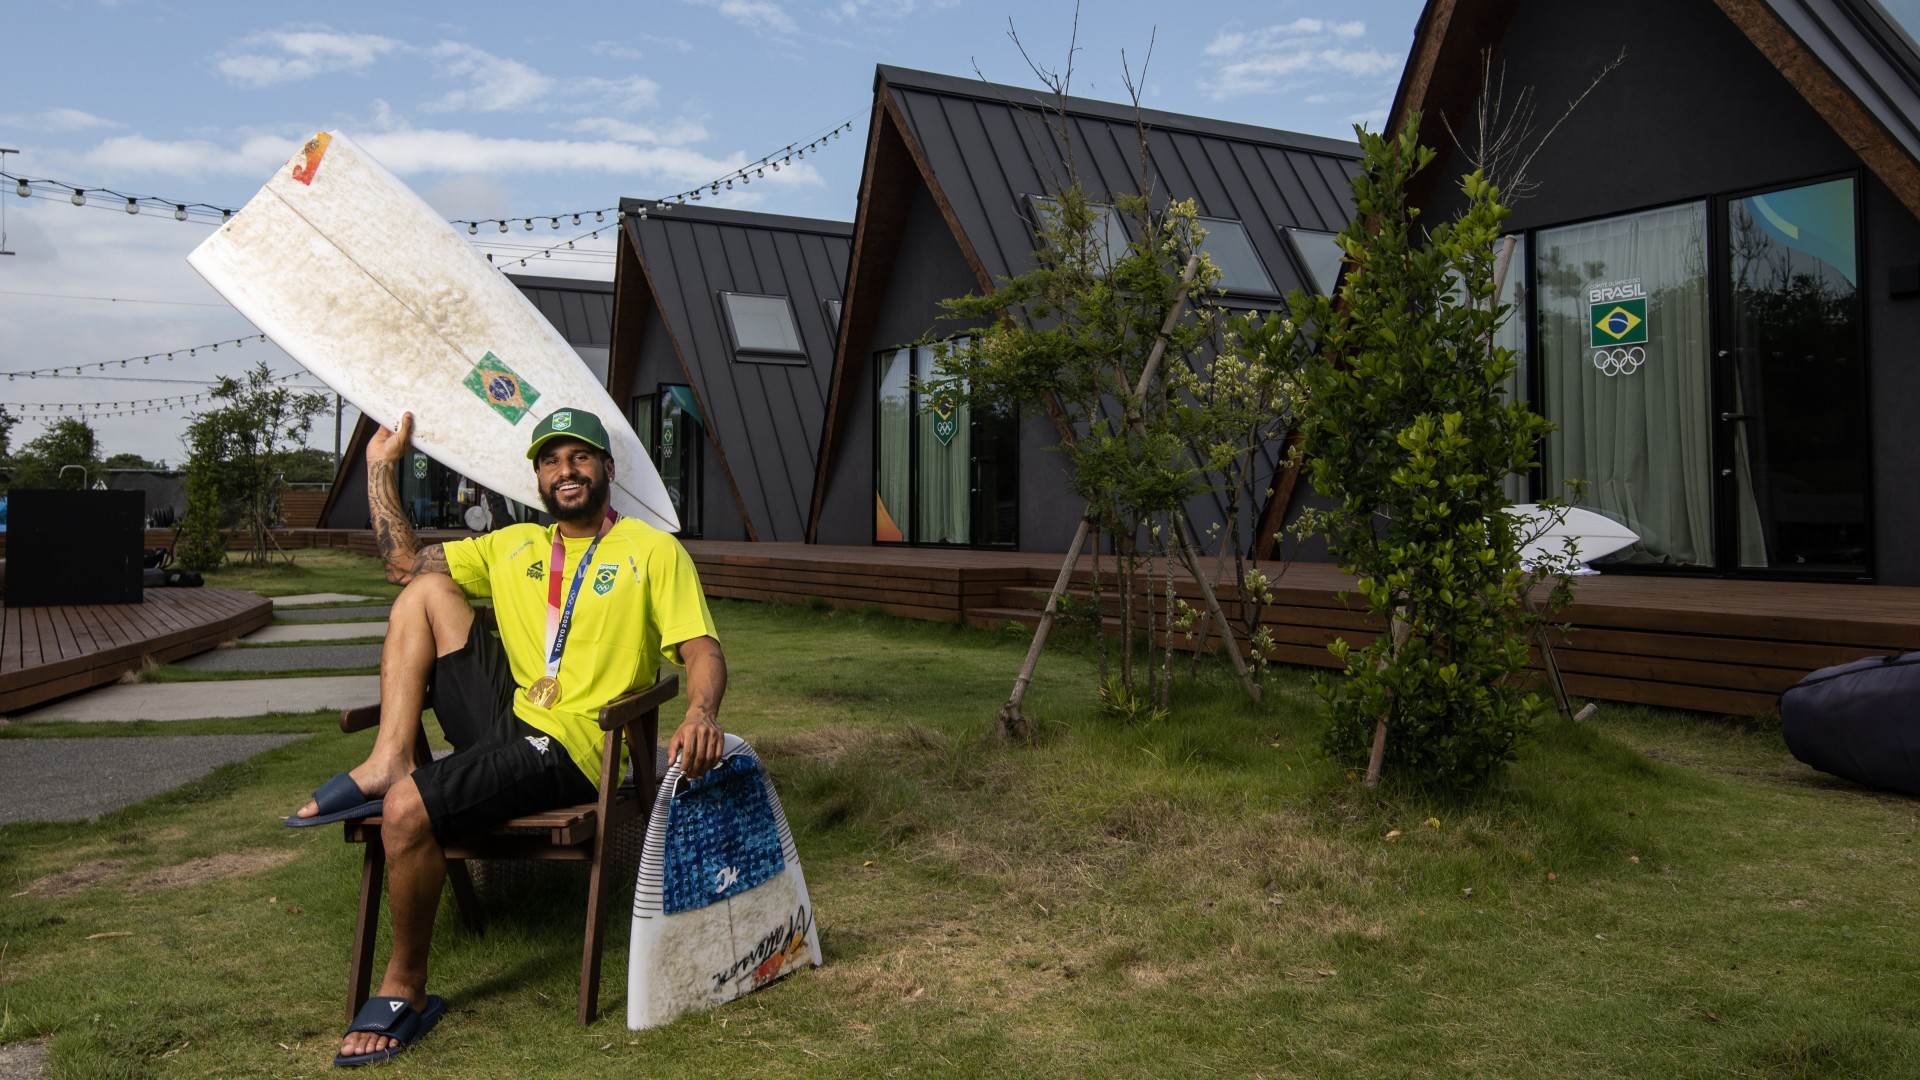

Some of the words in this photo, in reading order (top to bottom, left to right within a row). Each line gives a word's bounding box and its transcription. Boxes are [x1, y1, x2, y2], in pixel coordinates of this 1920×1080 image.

[1590, 283, 1646, 302] BRASIL
[555, 629, 565, 652] TOKYO
[562, 610, 570, 628] 2020
